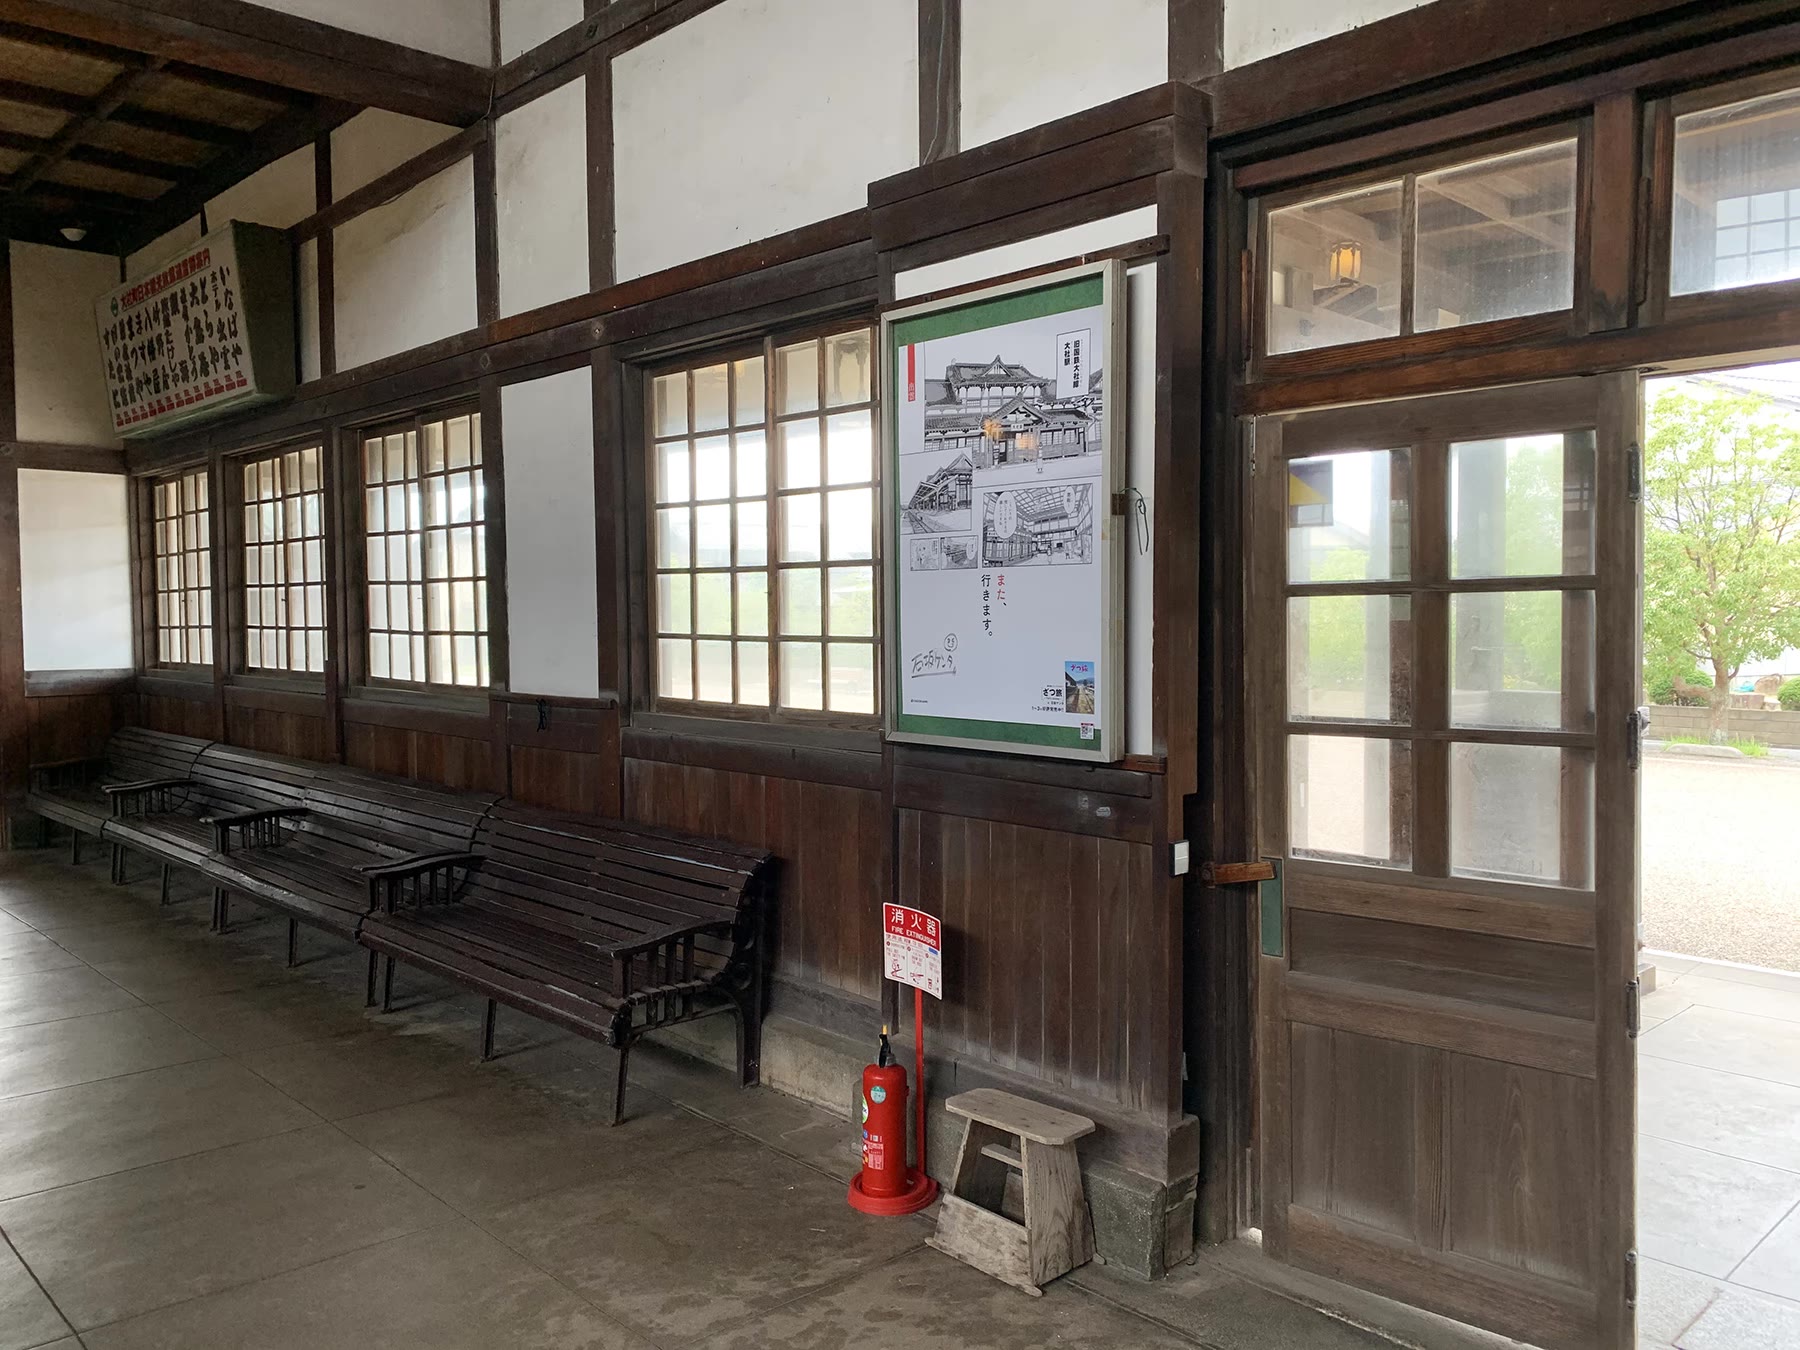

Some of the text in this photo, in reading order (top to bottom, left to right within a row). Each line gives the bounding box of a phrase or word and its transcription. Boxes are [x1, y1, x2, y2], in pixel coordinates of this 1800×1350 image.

[997, 574, 1007, 606] また、
[981, 574, 993, 636] 行きます。
[1043, 688, 1062, 697] ざつ旅
[891, 908, 936, 936] 消火器
[891, 926, 904, 934] FIRE
[906, 929, 937, 946] EXTINGUISHER
